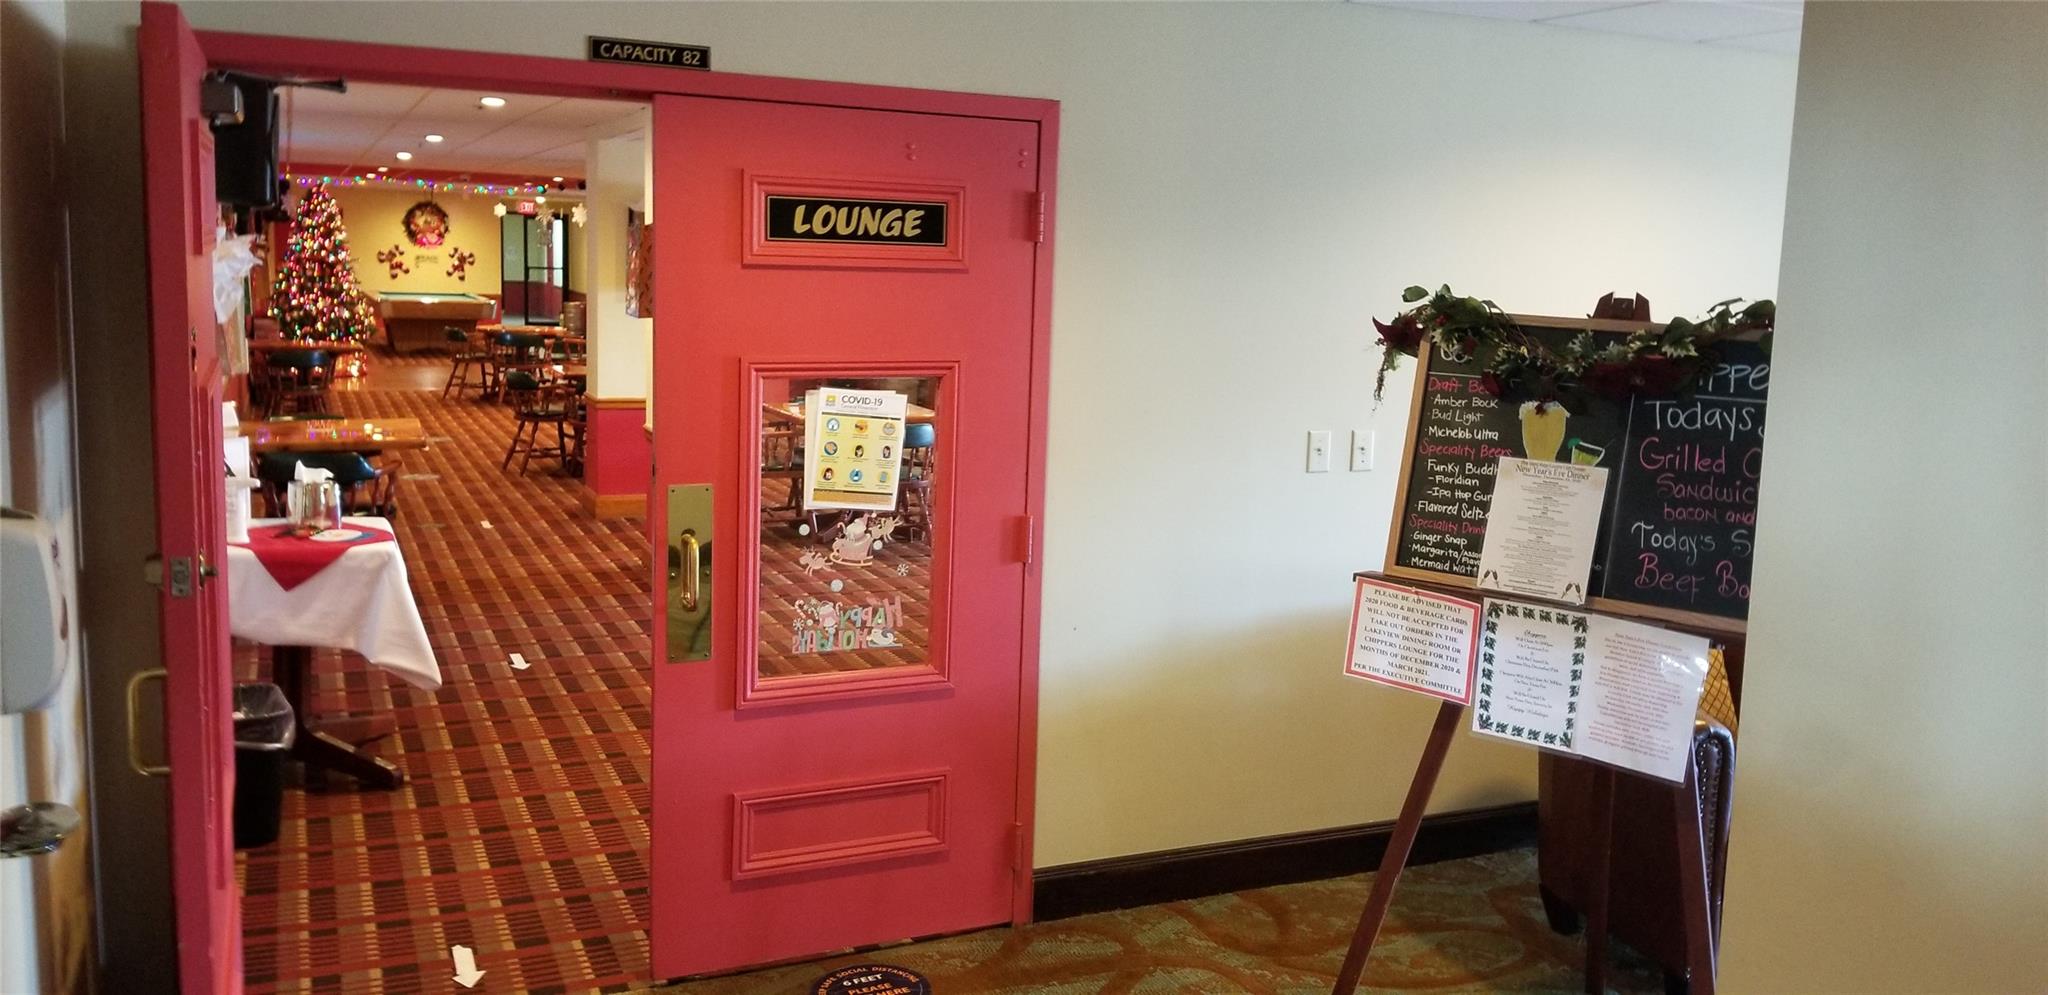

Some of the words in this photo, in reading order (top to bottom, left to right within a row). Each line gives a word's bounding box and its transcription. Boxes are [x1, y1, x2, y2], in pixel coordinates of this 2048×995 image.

[600, 43, 677, 62] CAPACITY
[682, 50, 701, 64] 82
[793, 204, 925, 237] LOUNGE
[1428, 376, 1462, 392] Draft
[841, 395, 883, 407] COVID-19
[1434, 394, 1468, 407] Amber
[1472, 397, 1498, 409] Bock
[1432, 409, 1452, 420] Bud
[1455, 409, 1484, 426] Light
[1643, 400, 1755, 442] Todays
[1428, 425, 1472, 439] Michelob
[1474, 429, 1499, 440] Ultra
[1419, 438, 1475, 460] Speciality
[1480, 444, 1512, 457] Beers
[1640, 437, 1725, 474] Grilled
[1515, 463, 1532, 473] New
[1553, 469, 1566, 477] Eve
[1566, 470, 1591, 480] Dinner
[1455, 489, 1471, 501] Hop
[1418, 500, 1459, 515] Flavored
[1409, 513, 1458, 535] Speciality
[1413, 531, 1442, 546] Ginger
[1444, 534, 1468, 549] Snap
[1631, 521, 1715, 566] Today's
[1411, 556, 1450, 571] Mermaid
[1634, 552, 1705, 604] Beef
[1365, 597, 1379, 605] 2020
[1379, 599, 1399, 610] FOOD
[1406, 606, 1446, 620] BEVERAGE
[1446, 615, 1468, 626] CARDS
[1374, 589, 1399, 600] PLEASE
[1412, 597, 1442, 609] ADVISED
[1443, 603, 1461, 614] THAT
[1367, 607, 1384, 616] WILL
[1385, 611, 1400, 620] NOT
[1412, 617, 1452, 631] ACCEPTED
[1450, 626, 1464, 635] FOR
[1371, 617, 1388, 627] TAKE
[1390, 622, 1404, 630] OUT
[1405, 625, 1434, 638] ORDERS
[1444, 635, 1458, 643] THE
[1364, 626, 1400, 639] LAKEVIEW
[1402, 635, 1427, 646] DINING
[1428, 640, 1451, 651] ROOM
[1451, 647, 1461, 655] OR
[1364, 636, 1397, 648] CHIPPERS
[1398, 644, 1428, 656] LOUNGE
[1429, 651, 1444, 660] FOR
[1445, 655, 1459, 664] THE
[1360, 644, 1388, 656] MONTHS
[1390, 651, 1399, 659] OF
[1400, 654, 1440, 669] DECEMBER
[1440, 664, 1455, 673] 2020
[1387, 661, 1413, 672] MARCH
[1368, 665, 1381, 673] THE
[1382, 669, 1422, 684] EXECUTIVE
[836, 968, 869, 978] SOCIAL
[853, 973, 882, 985] FEET
[848, 983, 892, 995] PLEASE
